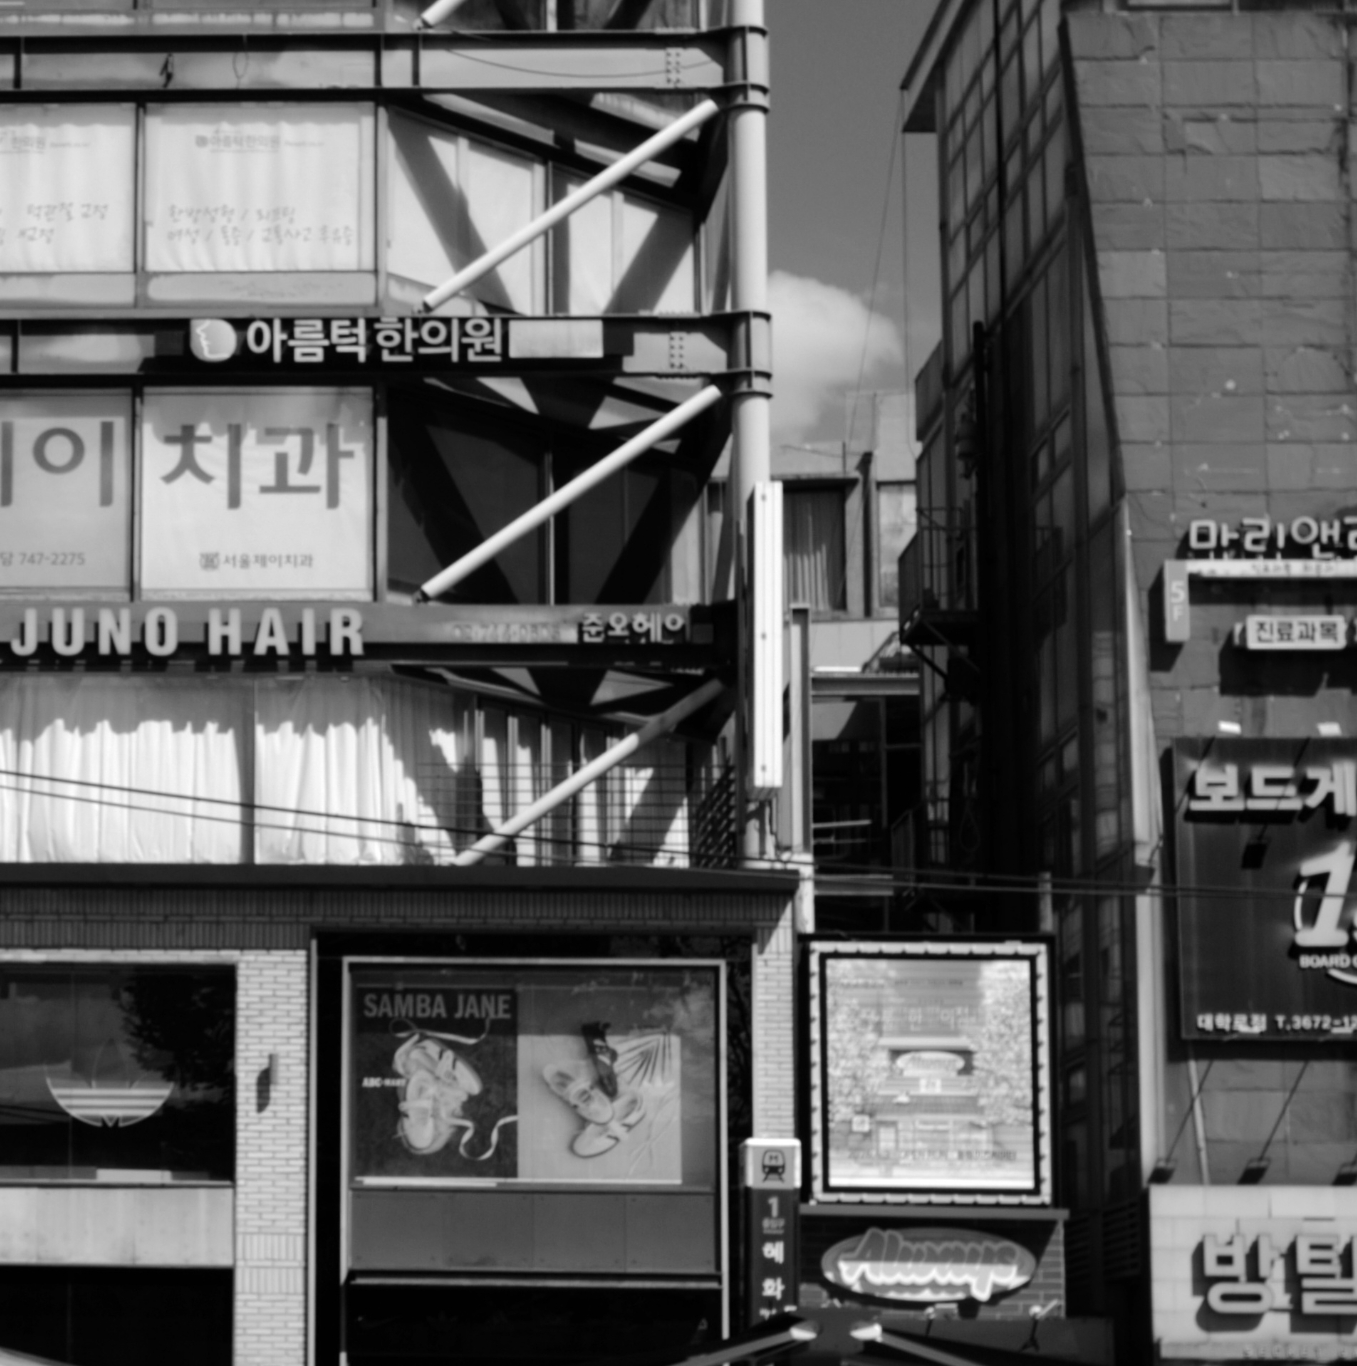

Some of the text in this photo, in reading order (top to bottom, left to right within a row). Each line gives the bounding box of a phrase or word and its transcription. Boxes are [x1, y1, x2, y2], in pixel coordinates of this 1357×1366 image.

[245, 317, 503, 363] 아름턱한의원
[19, 551, 86, 566] 747-2275
[223, 553, 314, 569] 서울제이치과
[11, 607, 365, 658] JUNO HAIR
[1256, 620, 1339, 644] 진료과목
[1299, 954, 1351, 969] BOARD
[363, 993, 512, 1020] SAMBA JANE
